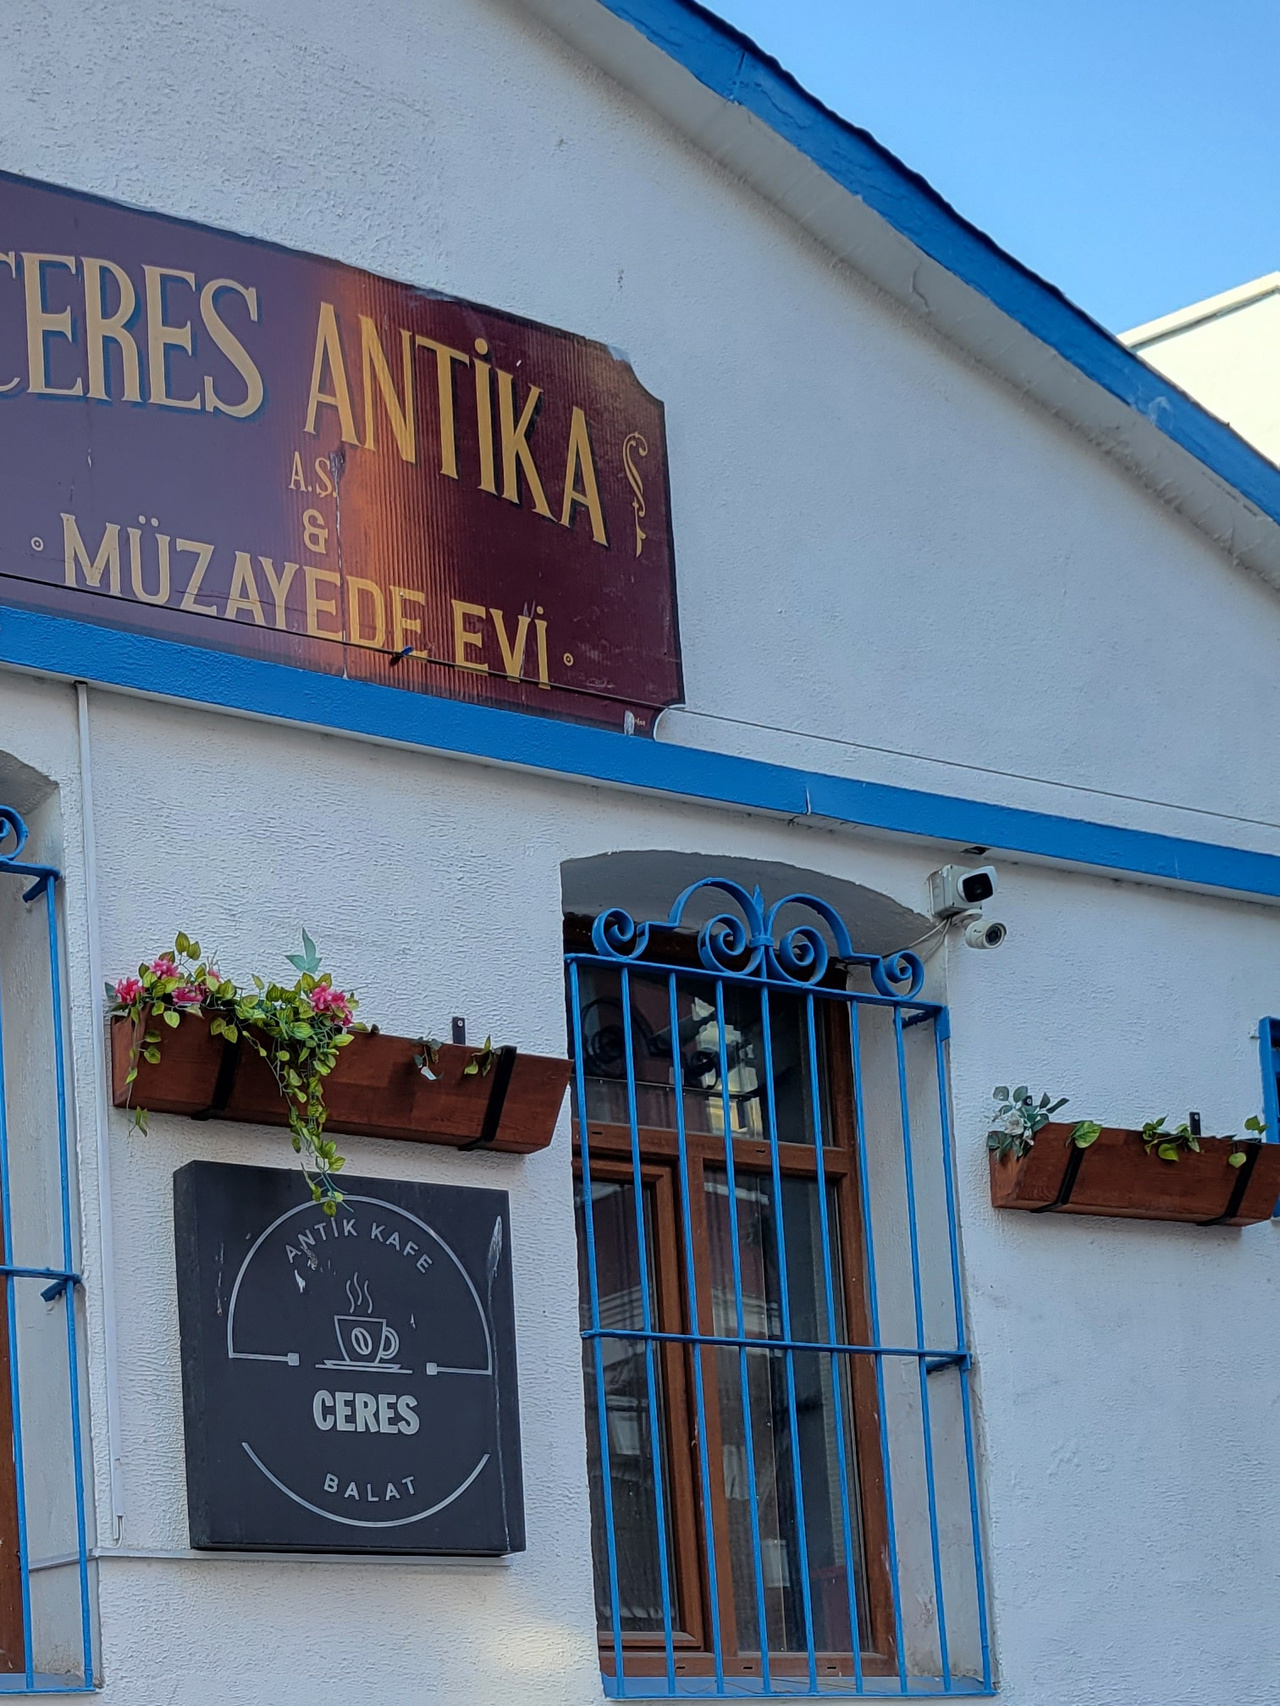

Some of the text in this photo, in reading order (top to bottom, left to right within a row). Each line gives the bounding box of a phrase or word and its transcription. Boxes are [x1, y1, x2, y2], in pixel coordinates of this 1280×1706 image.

[304, 301, 609, 548] ANTİKA
[302, 508, 329, 554] &
[60, 513, 551, 690] MÜZAYEDE EVİ
[371, 1222, 433, 1274] KAFE
[313, 1389, 420, 1436] CERES
[323, 1473, 416, 1502] BALAT
